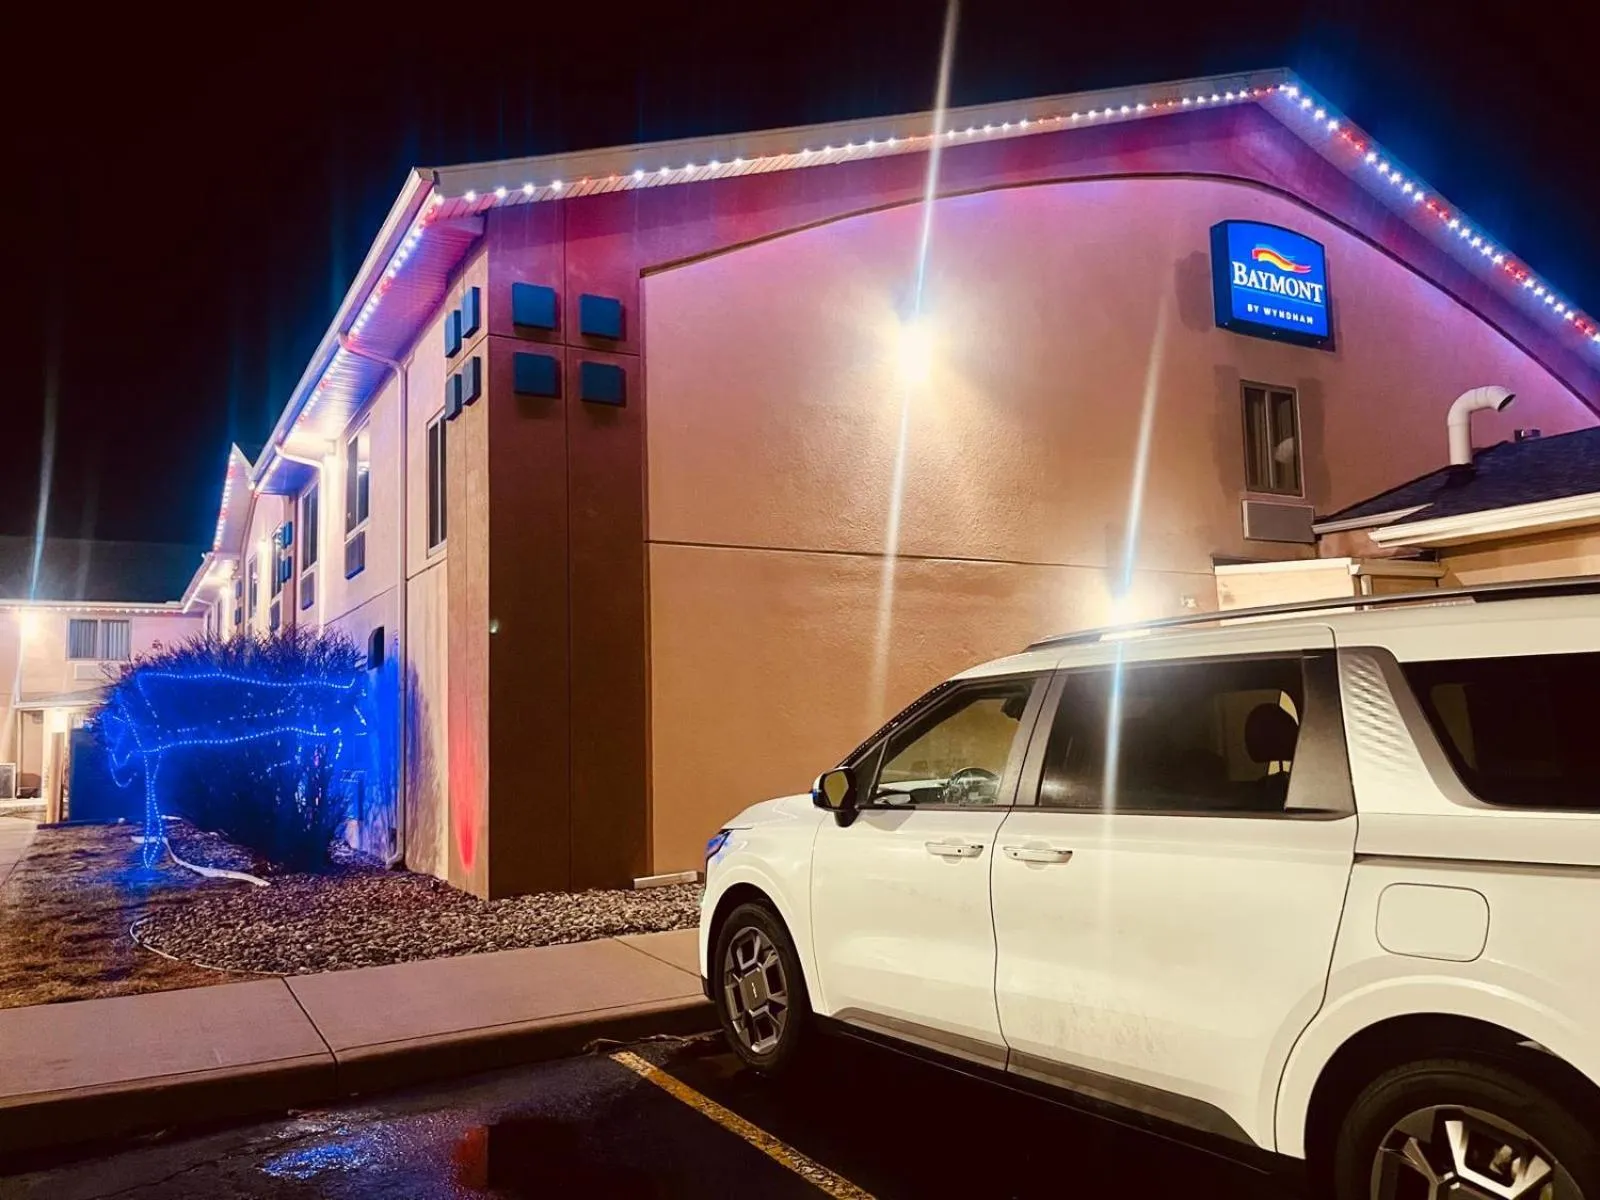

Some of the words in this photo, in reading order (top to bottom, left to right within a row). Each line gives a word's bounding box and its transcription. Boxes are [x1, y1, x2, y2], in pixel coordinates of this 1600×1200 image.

[1232, 261, 1323, 303] BAYMONT
[1247, 303, 1259, 313] BY
[1263, 307, 1313, 325] WYNDHAM
